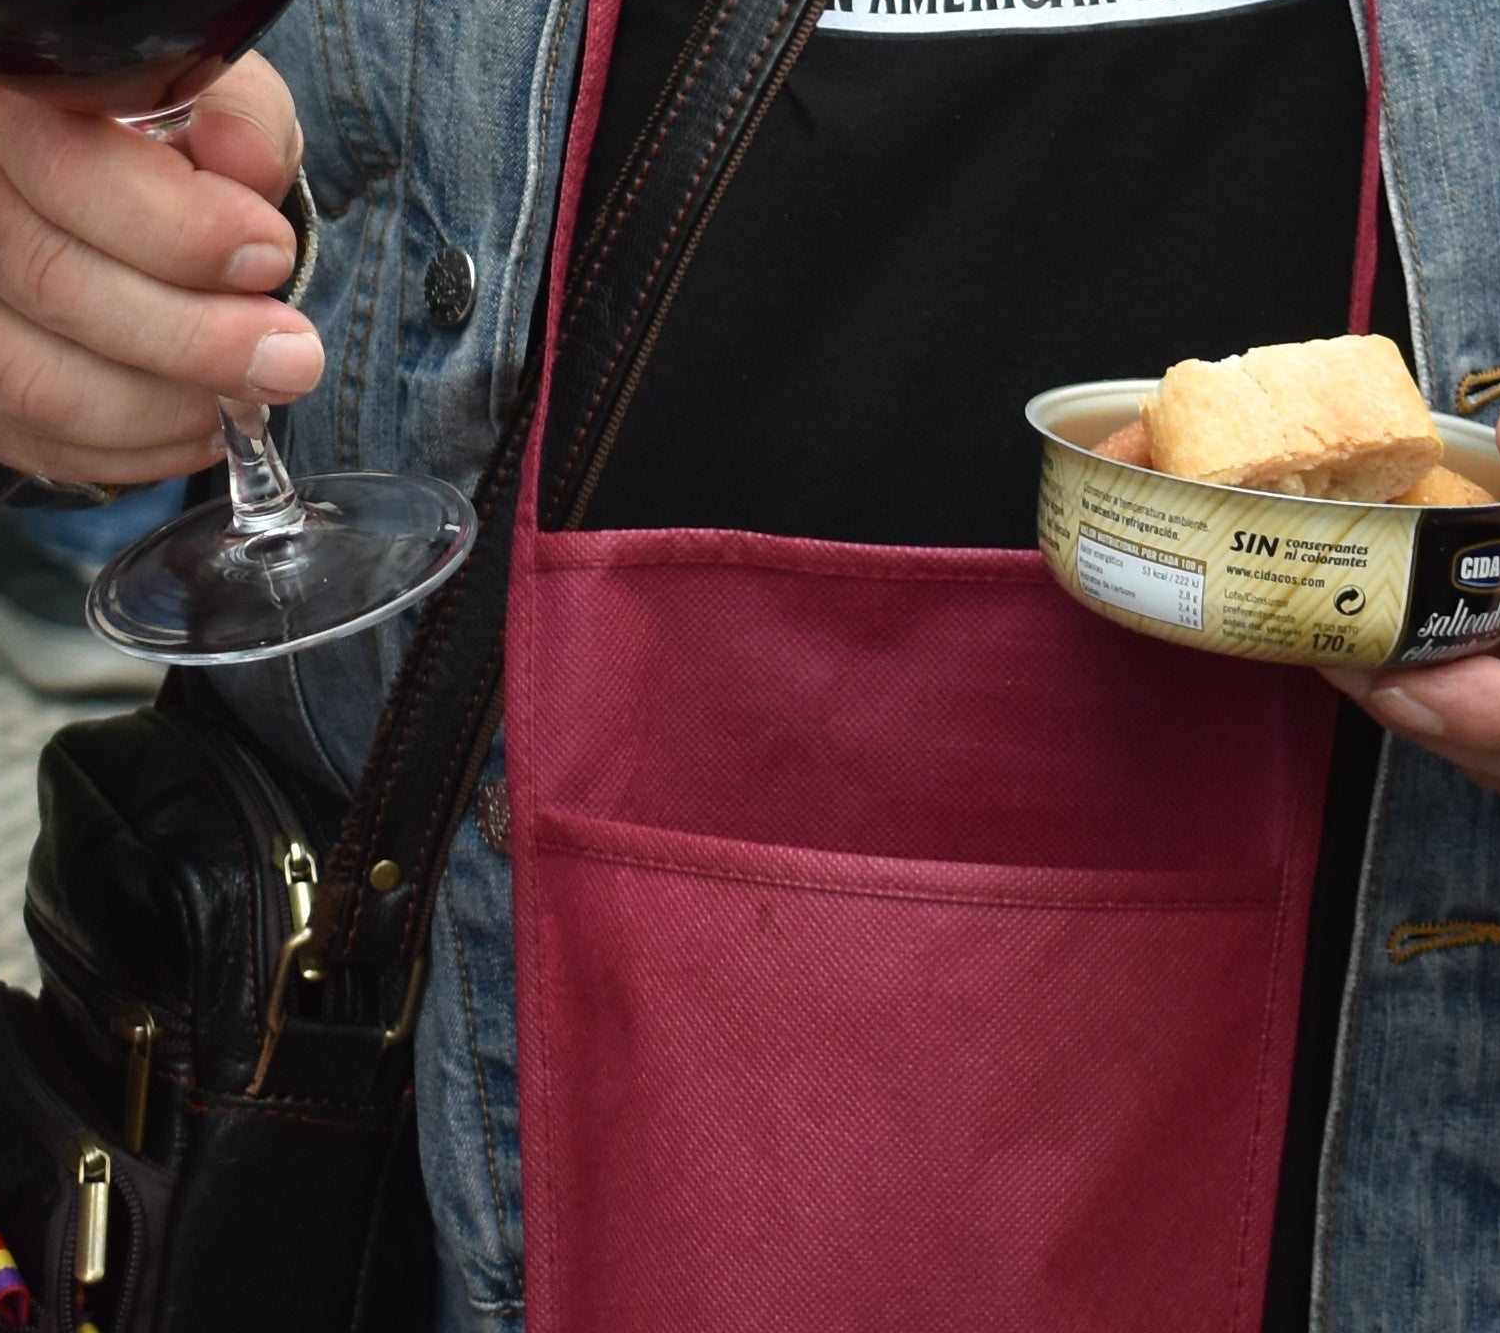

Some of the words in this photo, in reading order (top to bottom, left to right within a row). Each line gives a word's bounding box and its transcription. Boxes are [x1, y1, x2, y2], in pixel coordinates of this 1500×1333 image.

[1229, 530, 1280, 558] SIN
[1285, 538, 1370, 556] conservantes
[1284, 550, 1298, 561] ni
[1301, 553, 1368, 568] colorantes
[1226, 564, 1326, 589] www.cidacos.com
[1312, 633, 1345, 652] 170
